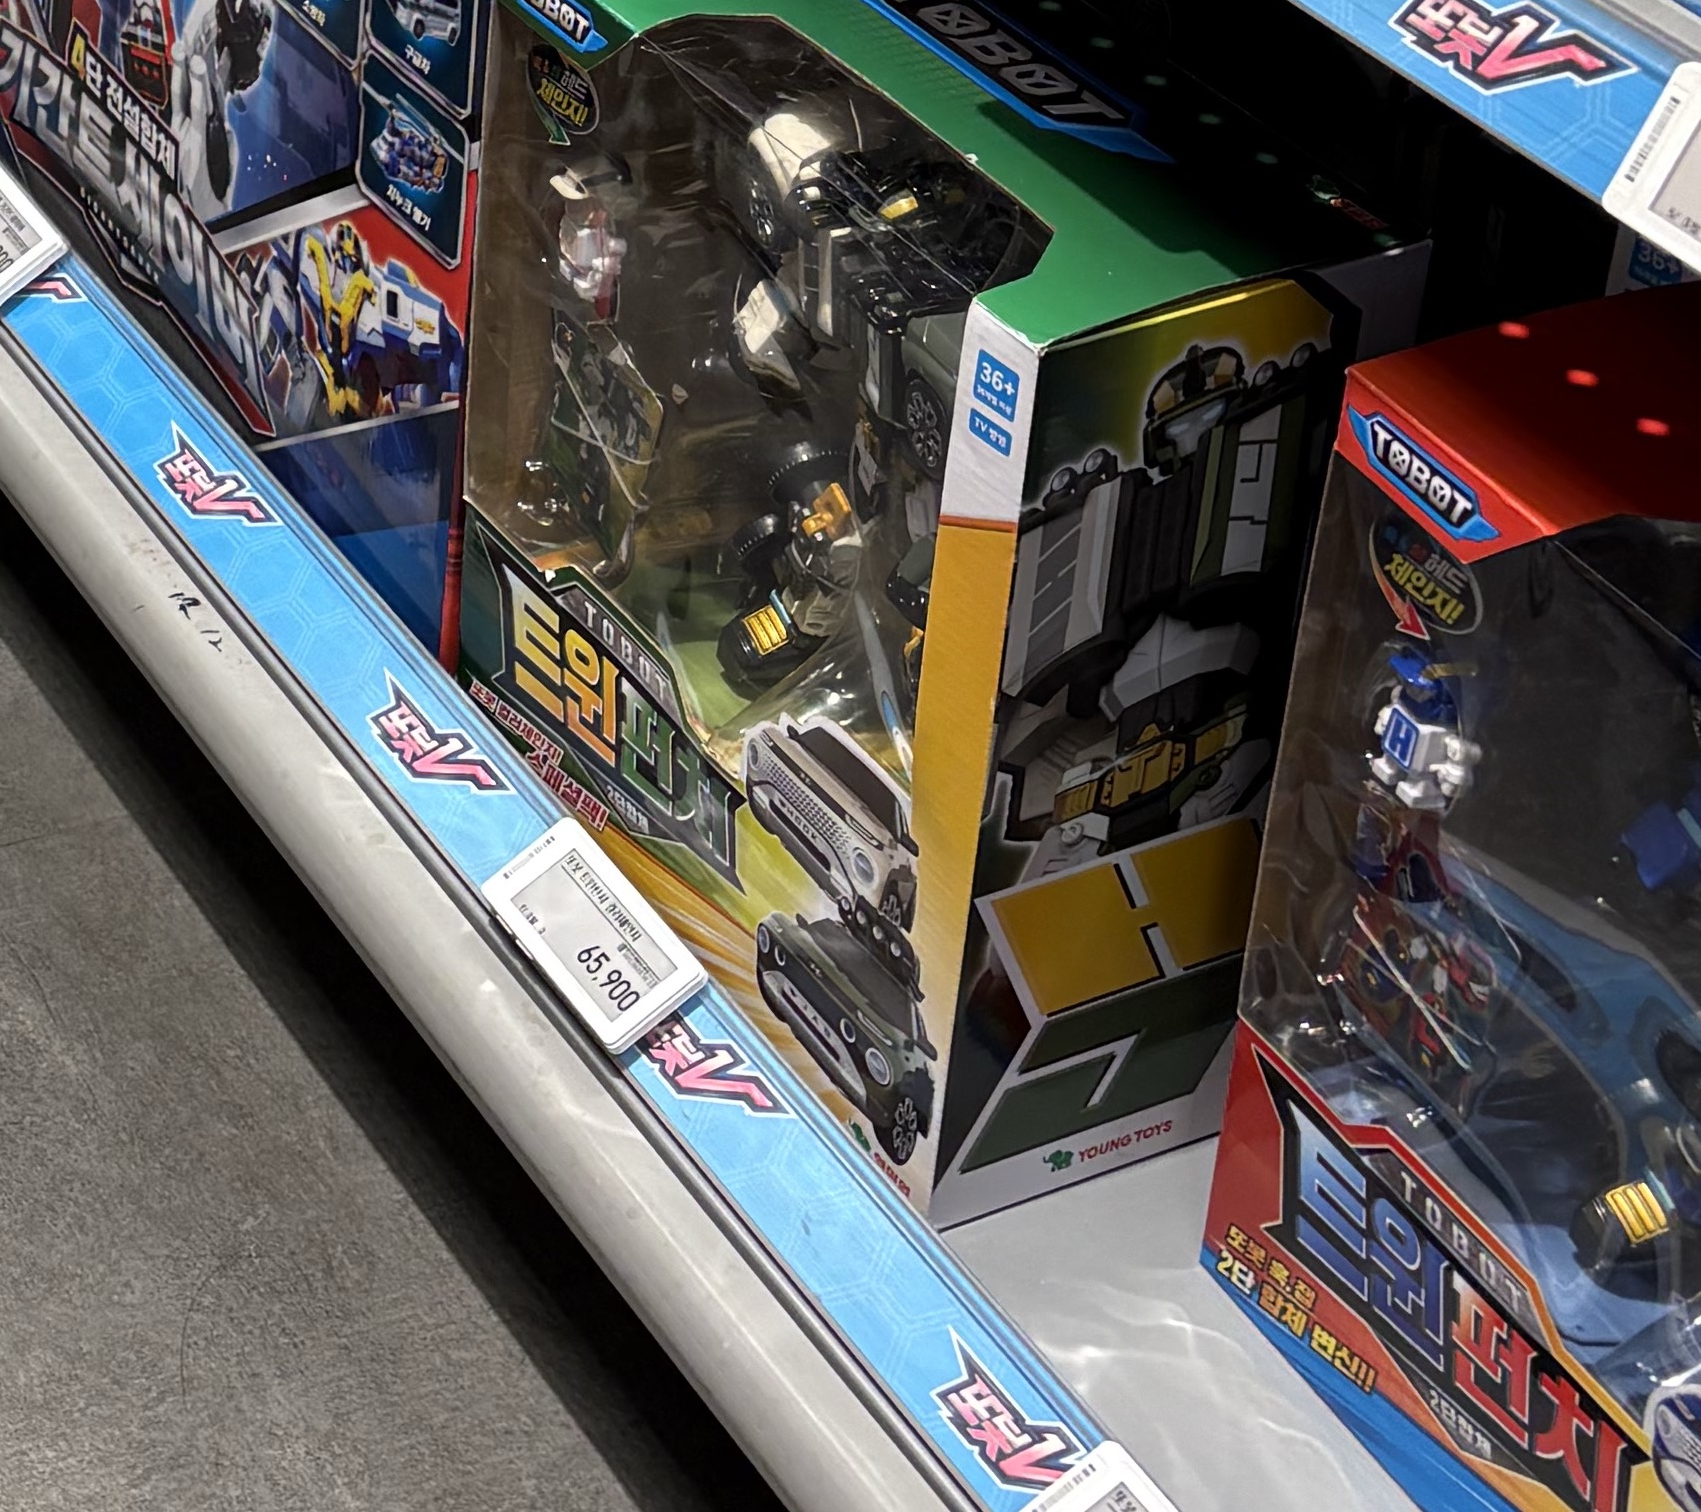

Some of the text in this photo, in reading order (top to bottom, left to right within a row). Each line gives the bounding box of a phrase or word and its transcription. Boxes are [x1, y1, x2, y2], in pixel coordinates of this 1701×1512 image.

[70, 32, 102, 94] 4단
[106, 72, 178, 180] 전설합체
[979, 361, 1016, 397] 36+
[973, 416, 988, 433] TV
[165, 443, 268, 524] 또봇V
[1373, 422, 1473, 525] TOBOT
[584, 600, 668, 702] TOBOT
[378, 701, 497, 789] 또봇V
[576, 943, 642, 1014] 65,900
[1077, 1119, 1173, 1163] YOUNG TOYS
[1226, 1224, 1266, 1268] 또봇
[1401, 1171, 1524, 1314] TOBOT
[1216, 1249, 1378, 1392] 2단 합체 변신!!
